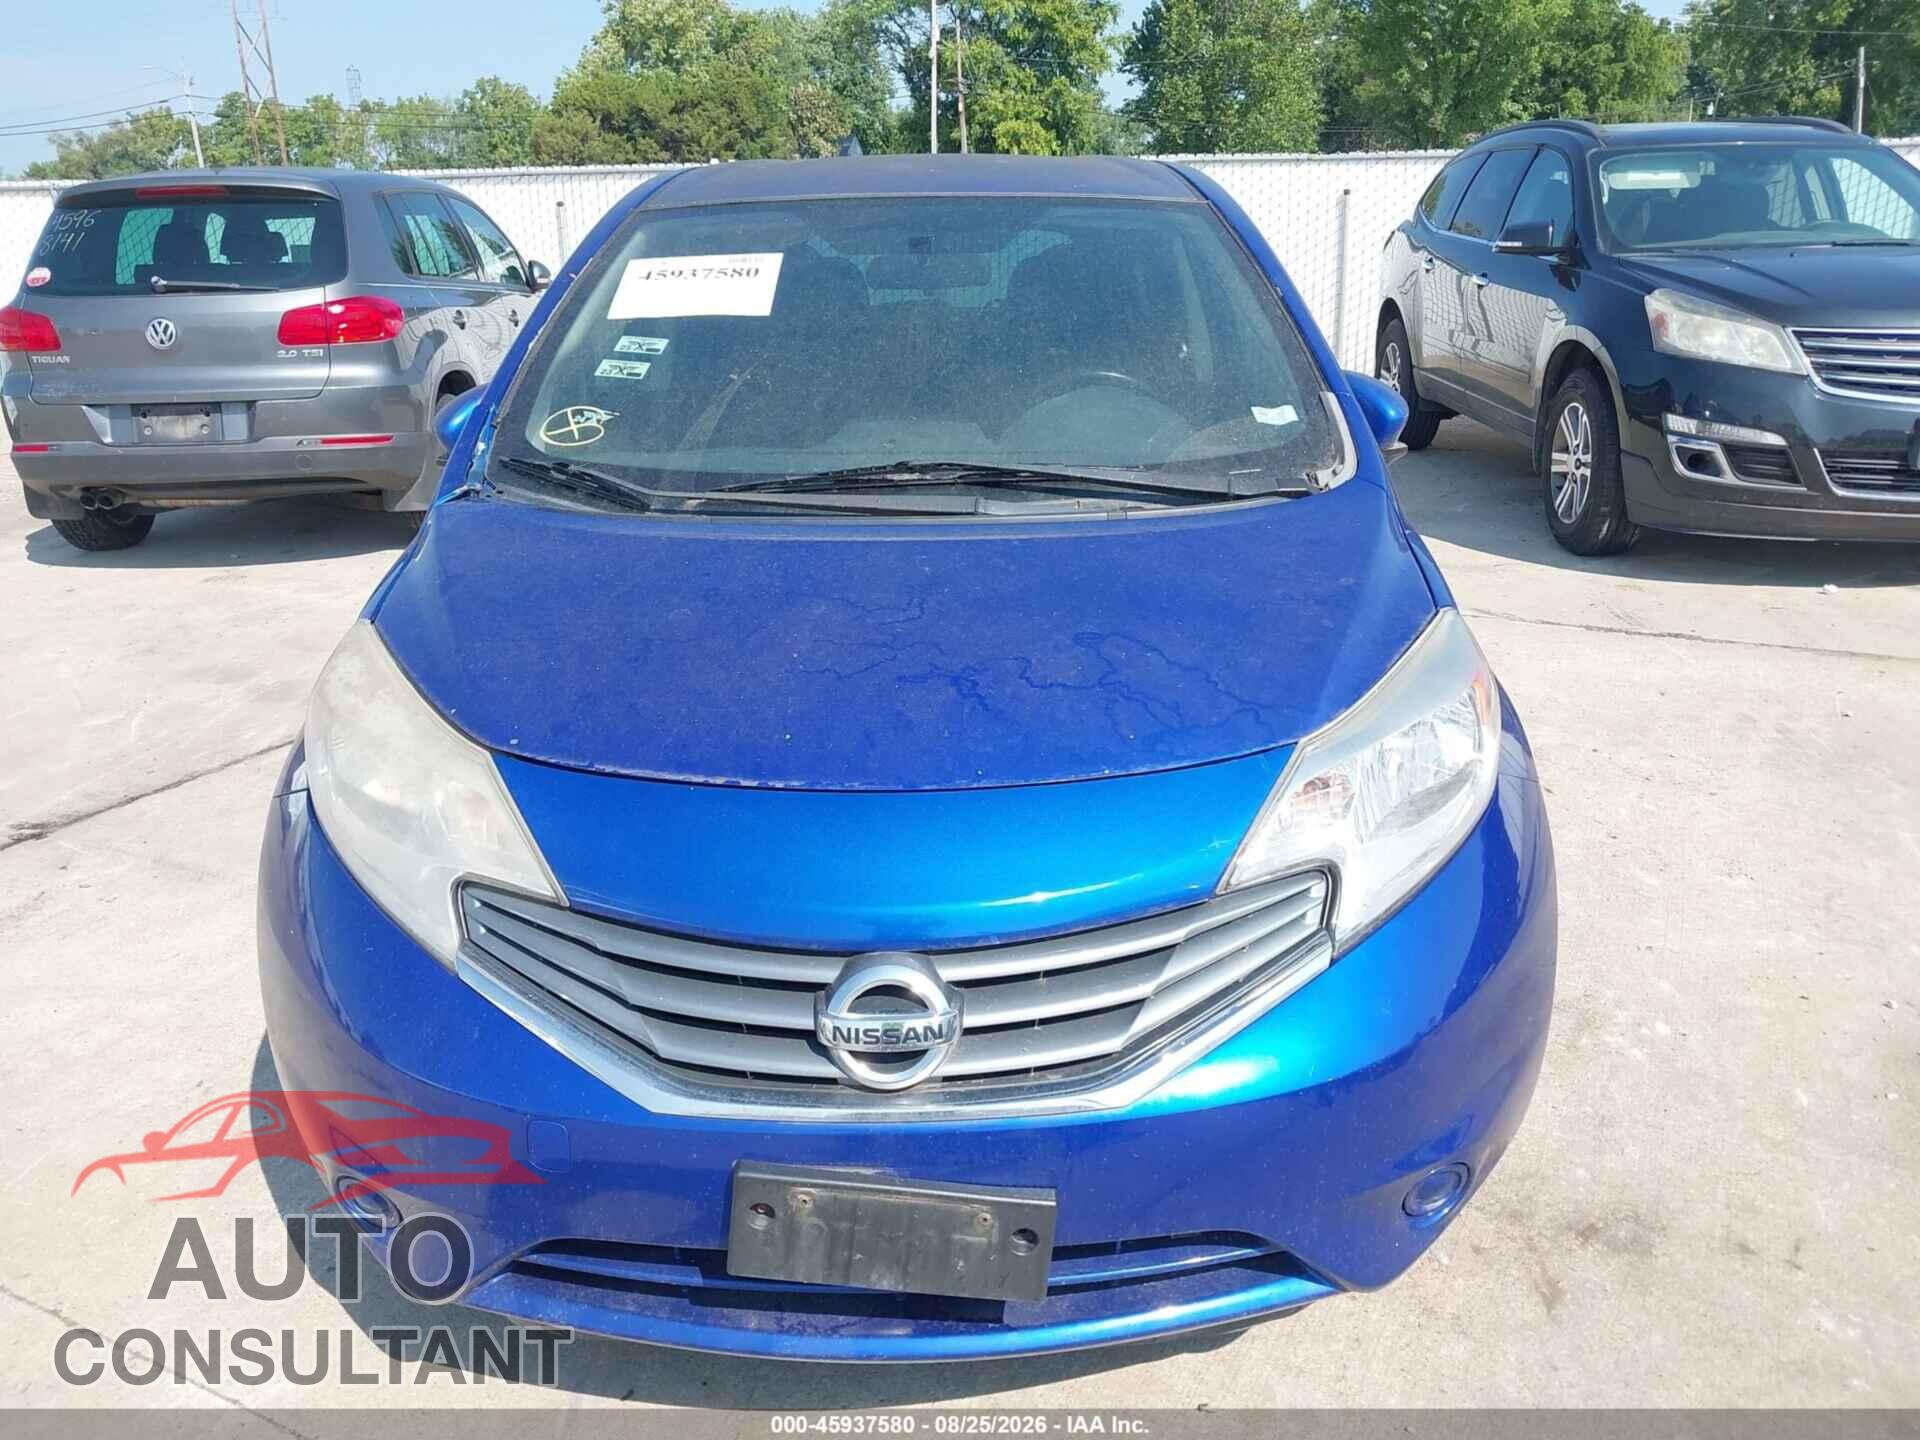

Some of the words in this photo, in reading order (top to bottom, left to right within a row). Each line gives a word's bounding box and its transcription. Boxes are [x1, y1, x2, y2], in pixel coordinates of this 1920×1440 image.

[638, 267, 760, 281] 45937580
[301, 349, 324, 357] TSI
[31, 355, 71, 364] TIGUAN
[832, 1023, 944, 1045] NISSAN
